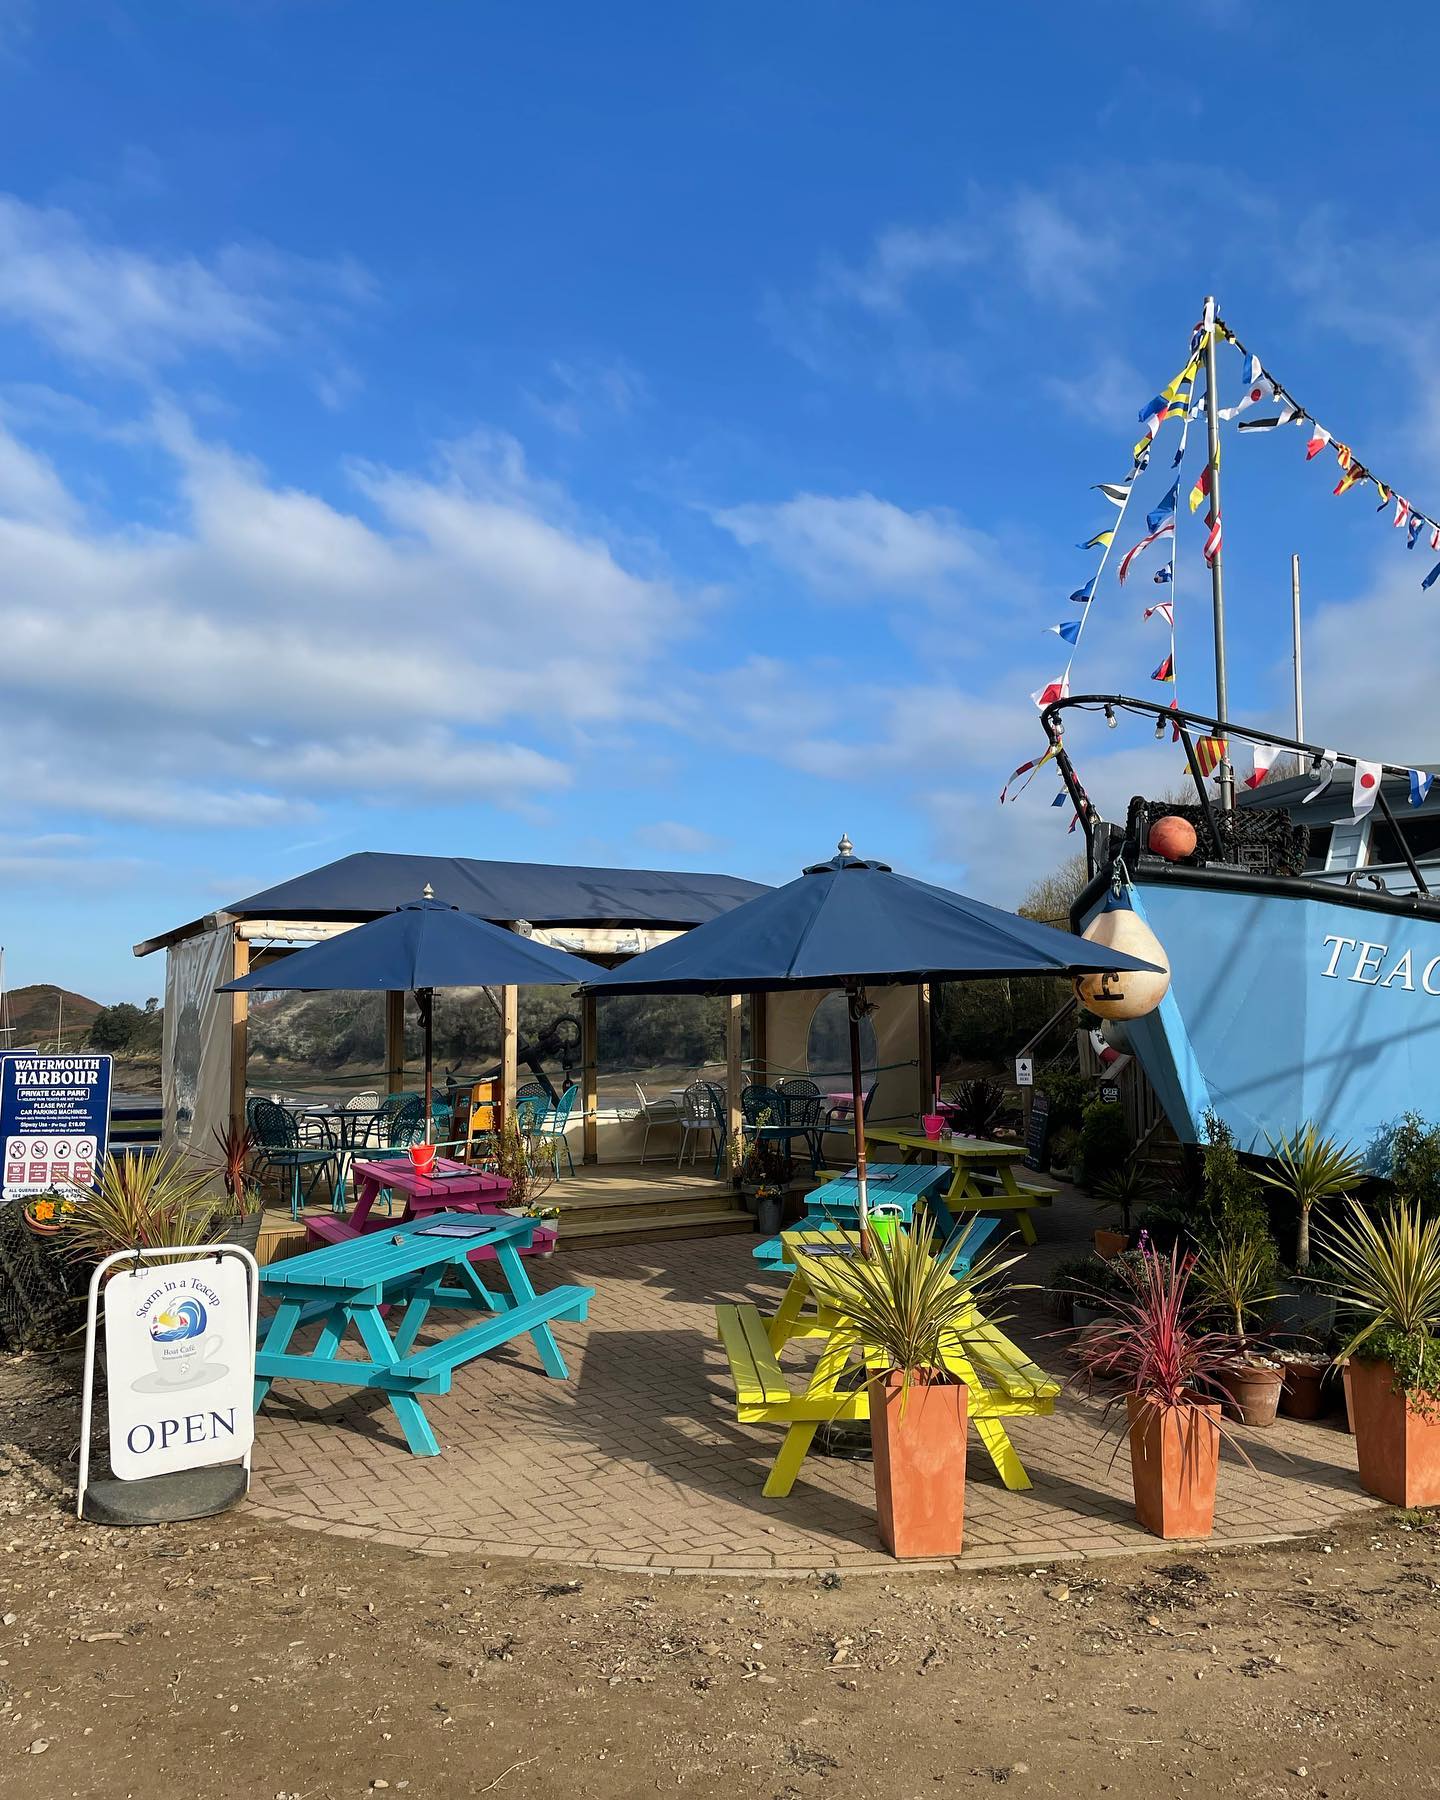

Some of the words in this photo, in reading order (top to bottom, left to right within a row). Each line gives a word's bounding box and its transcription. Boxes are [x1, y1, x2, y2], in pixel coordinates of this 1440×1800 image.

[14, 1060, 100, 1070] WATERMOUTH
[14, 1071, 98, 1085] HARBOUR
[136, 1288, 163, 1319] Storm
[164, 1280, 177, 1292] in
[179, 1280, 186, 1288] a
[191, 1277, 221, 1307] Teacup
[127, 1407, 237, 1454] OPEN
